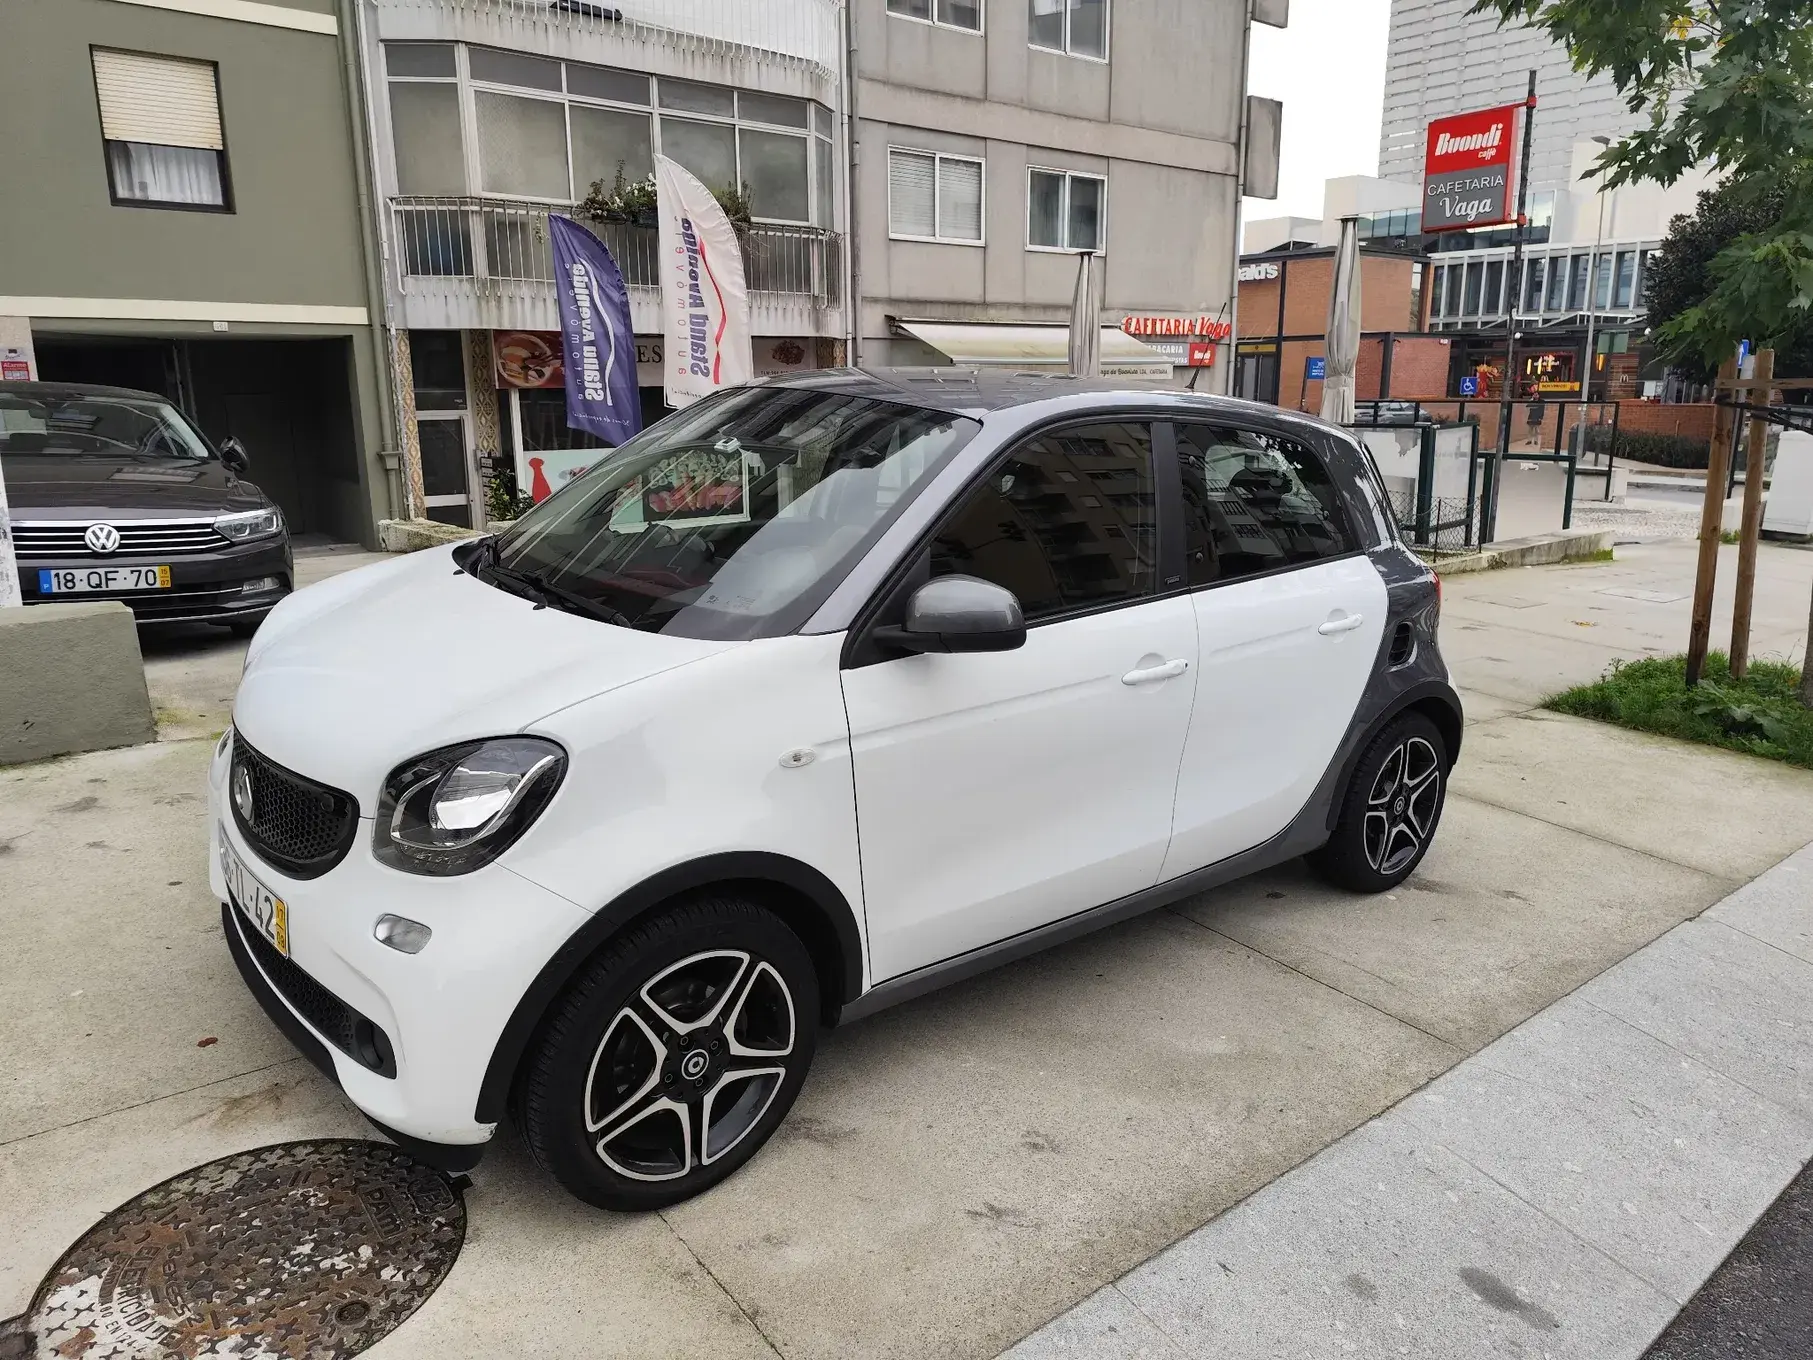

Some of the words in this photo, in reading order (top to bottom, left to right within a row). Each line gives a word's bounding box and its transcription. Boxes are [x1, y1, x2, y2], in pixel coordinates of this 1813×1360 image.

[1435, 123, 1503, 156] Buondi
[1427, 175, 1504, 196] CAFETARIA
[1439, 195, 1493, 222] Vaga
[1239, 263, 1278, 281] ald's
[1124, 317, 1195, 335] CAFETARIA
[276, 905, 284, 922] 17
